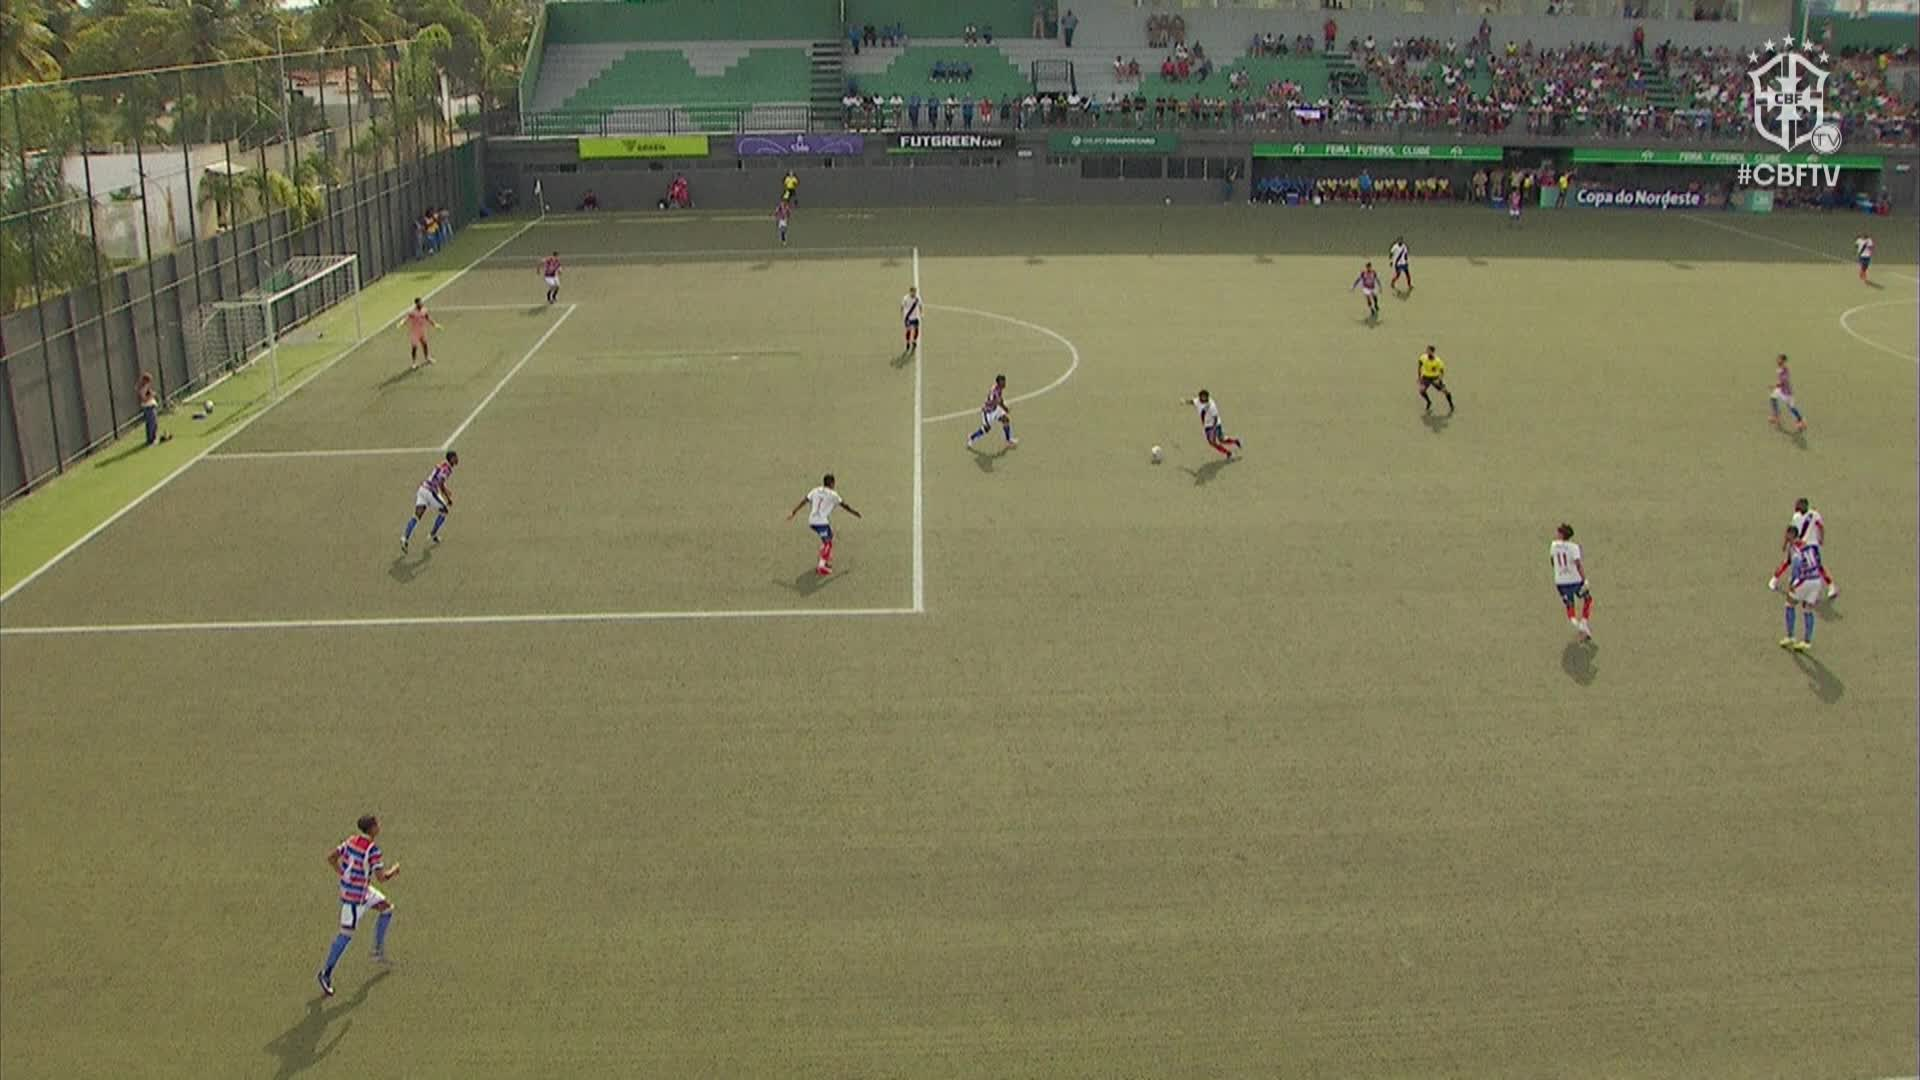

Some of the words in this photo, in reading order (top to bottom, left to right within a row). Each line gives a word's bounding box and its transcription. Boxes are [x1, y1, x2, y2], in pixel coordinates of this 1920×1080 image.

[900, 135, 981, 147] FUTGREEN
[1326, 144, 1350, 155] FEIRA
[1357, 144, 1395, 156] FUTEBOL
[1402, 145, 1431, 156] CLUBE
[1577, 189, 1612, 207] Copa
[1615, 190, 1633, 204] do
[1635, 190, 1700, 205] Nordeste
